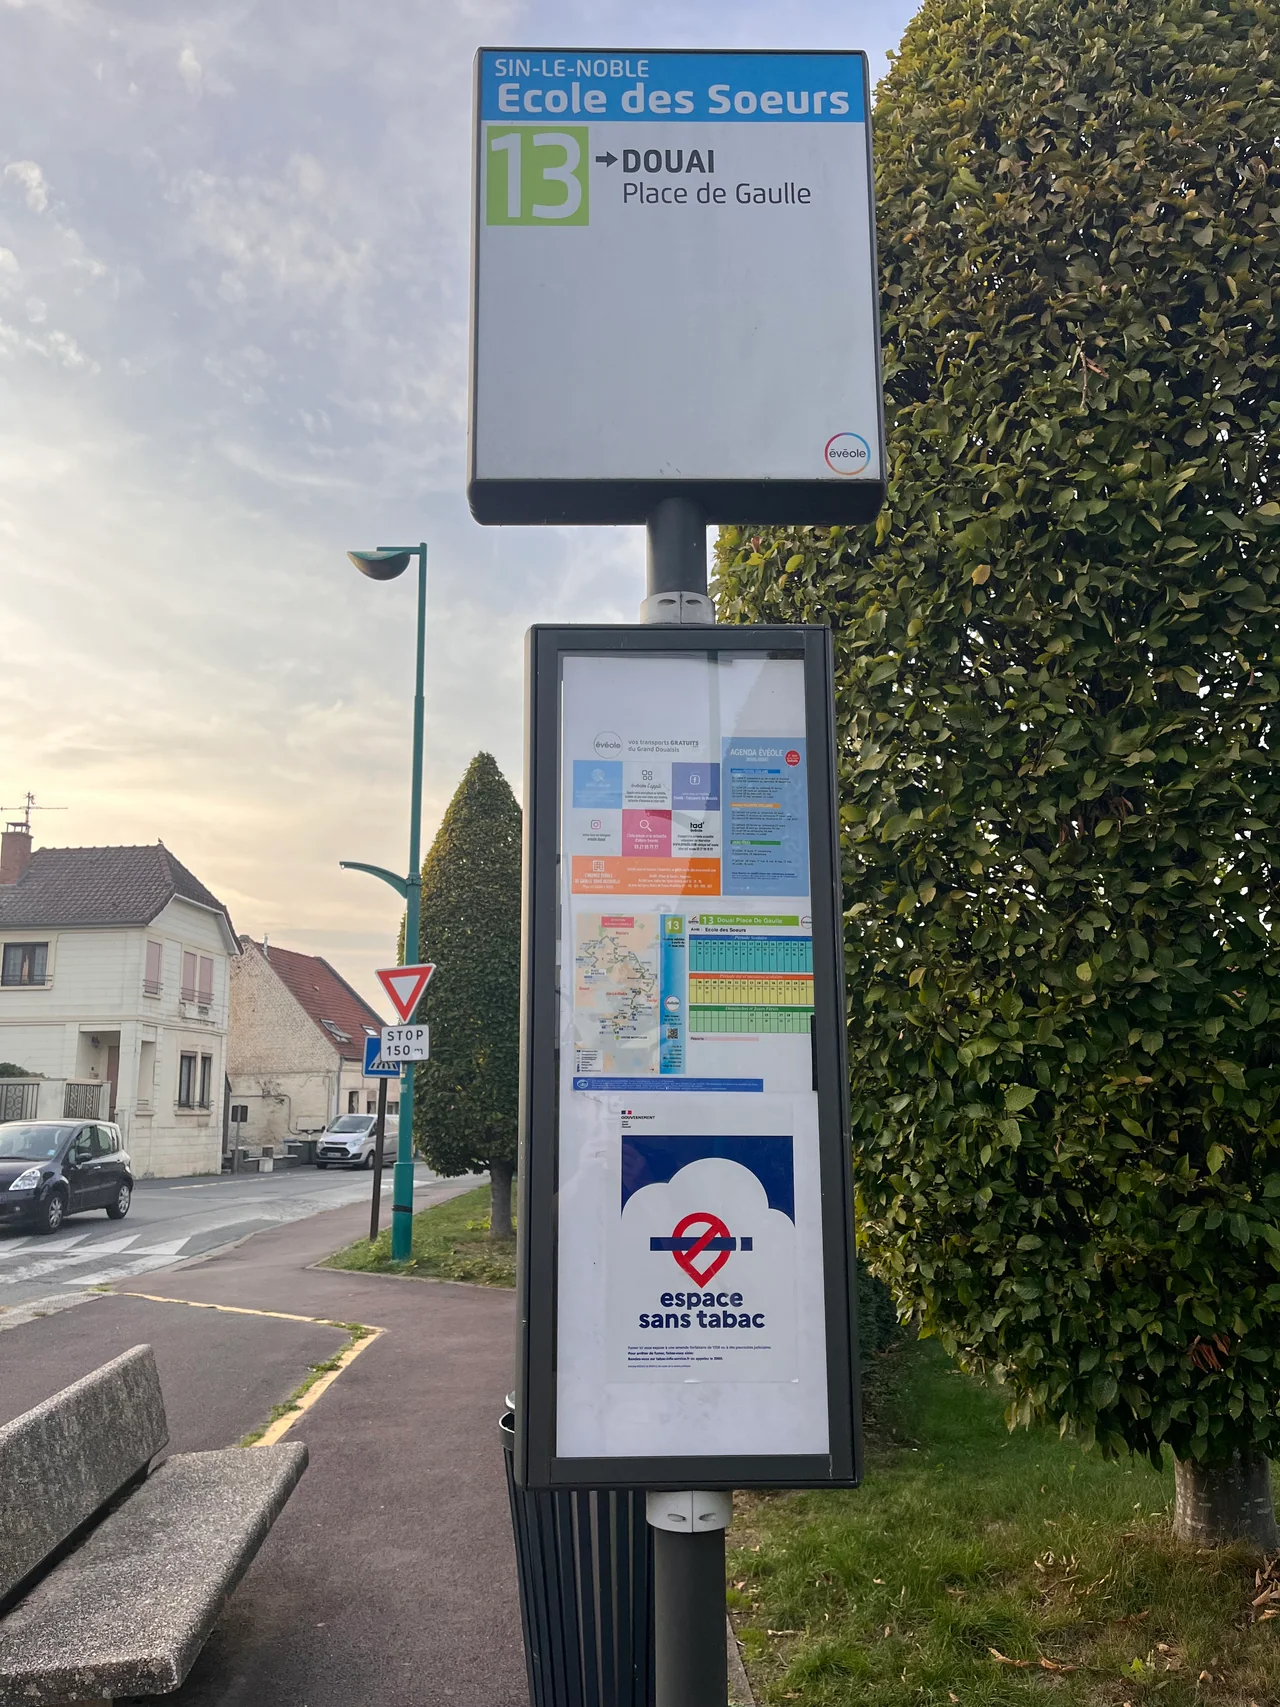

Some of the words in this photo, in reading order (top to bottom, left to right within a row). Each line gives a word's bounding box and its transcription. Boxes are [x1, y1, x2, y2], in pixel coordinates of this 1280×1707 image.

[495, 58, 650, 78] SIN-LE-NOBLE
[497, 82, 607, 114] Ecole
[621, 82, 695, 115] des
[707, 84, 850, 115] Soeurs
[622, 149, 715, 174] DOUAI
[490, 132, 583, 220] 13
[622, 182, 688, 204] Place
[697, 182, 727, 204] de
[736, 182, 812, 205] Gaulle
[730, 748, 757, 756] AGENDA
[667, 920, 680, 930] 13
[702, 916, 714, 924] 13
[387, 1030, 424, 1041] STOP
[386, 1045, 410, 1056] 150
[660, 1292, 743, 1310] espace
[638, 1312, 691, 1329] sans
[696, 1310, 765, 1329] tabac
